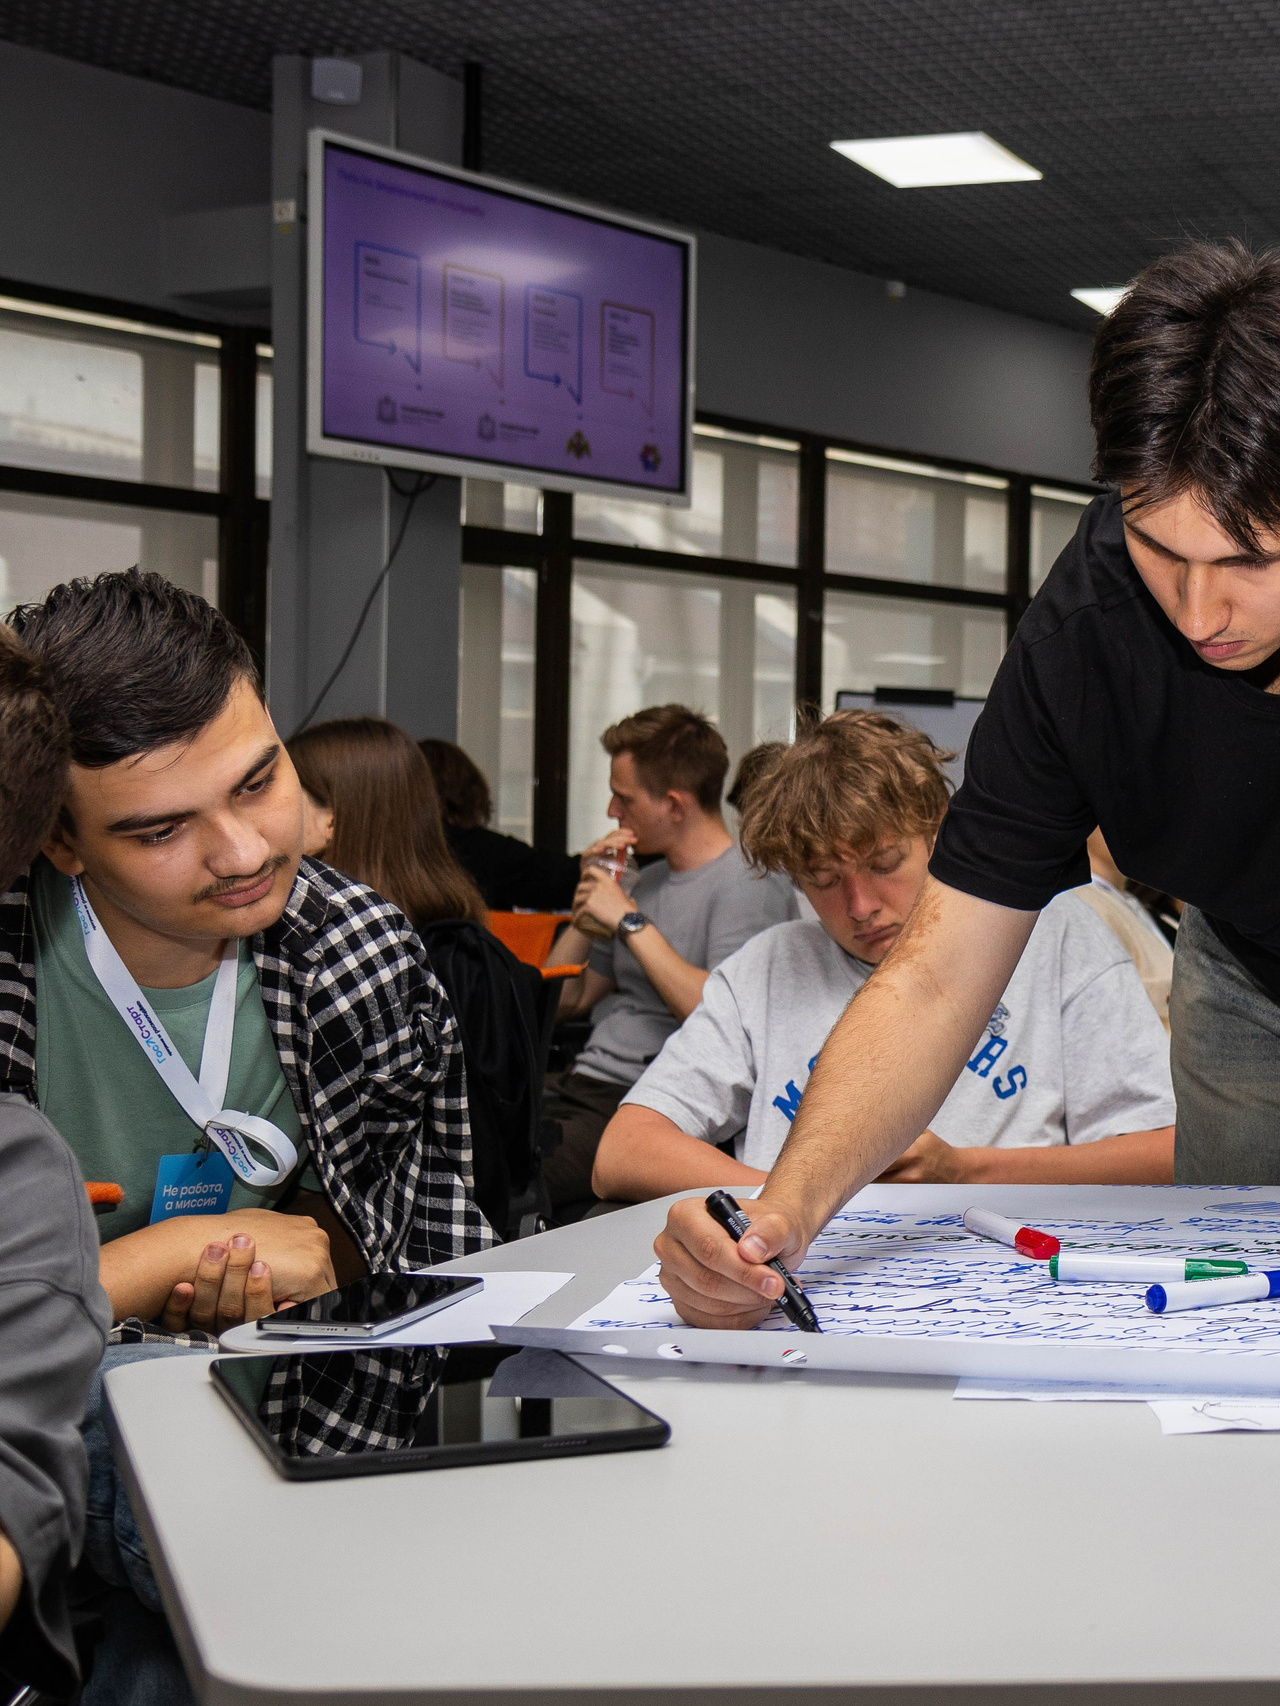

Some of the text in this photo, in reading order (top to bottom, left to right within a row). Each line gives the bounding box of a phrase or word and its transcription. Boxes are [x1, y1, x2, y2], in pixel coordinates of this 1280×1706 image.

[162, 1181, 224, 1198] Не работа,
[164, 1196, 218, 1211] а миссия
